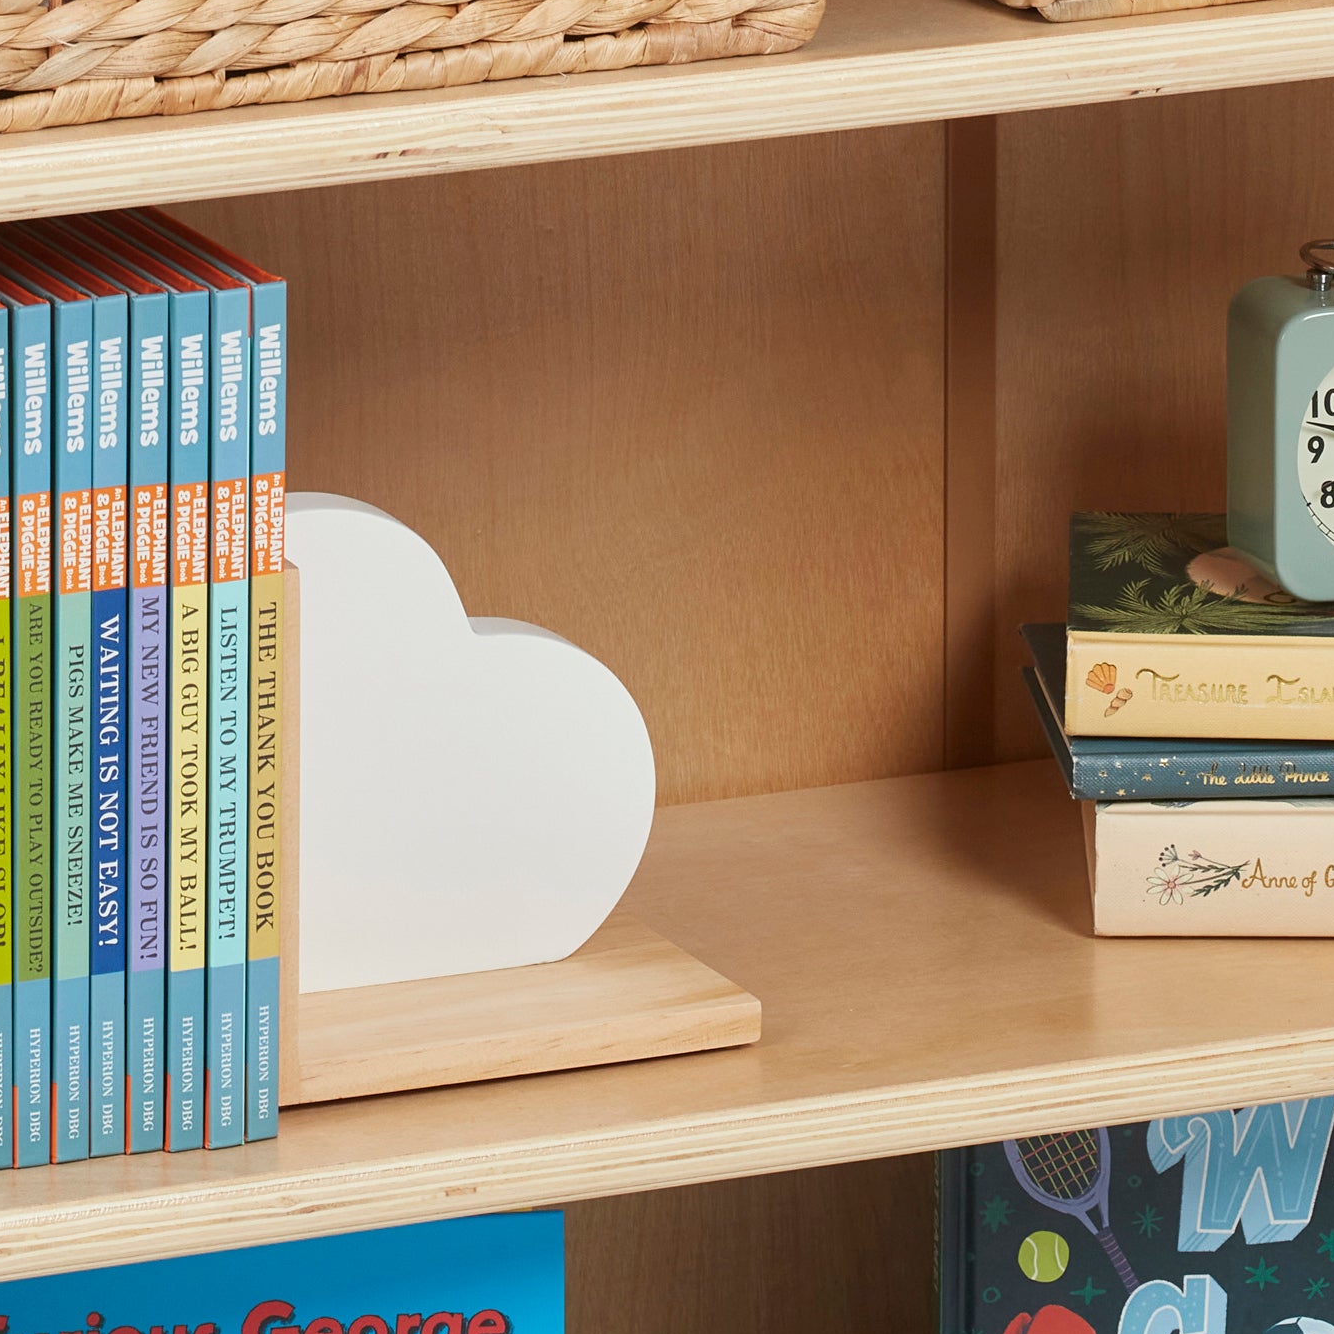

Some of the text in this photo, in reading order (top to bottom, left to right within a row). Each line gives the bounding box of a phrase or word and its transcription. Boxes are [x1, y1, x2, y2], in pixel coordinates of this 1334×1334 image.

[259, 324, 281, 436] Willems
[1307, 436, 1325, 463] 9
[255, 479, 268, 571] & PIGGIE Book
[269, 475, 283, 571] An ELEPHANT
[99, 613, 120, 947] WAITING IS NOT EASY!
[256, 601, 277, 930] THE THANK YOU BOOK
[1197, 763, 1227, 786] The
[1279, 761, 1329, 783] Prince
[1242, 858, 1297, 889] Anne
[1302, 870, 1317, 897] of
